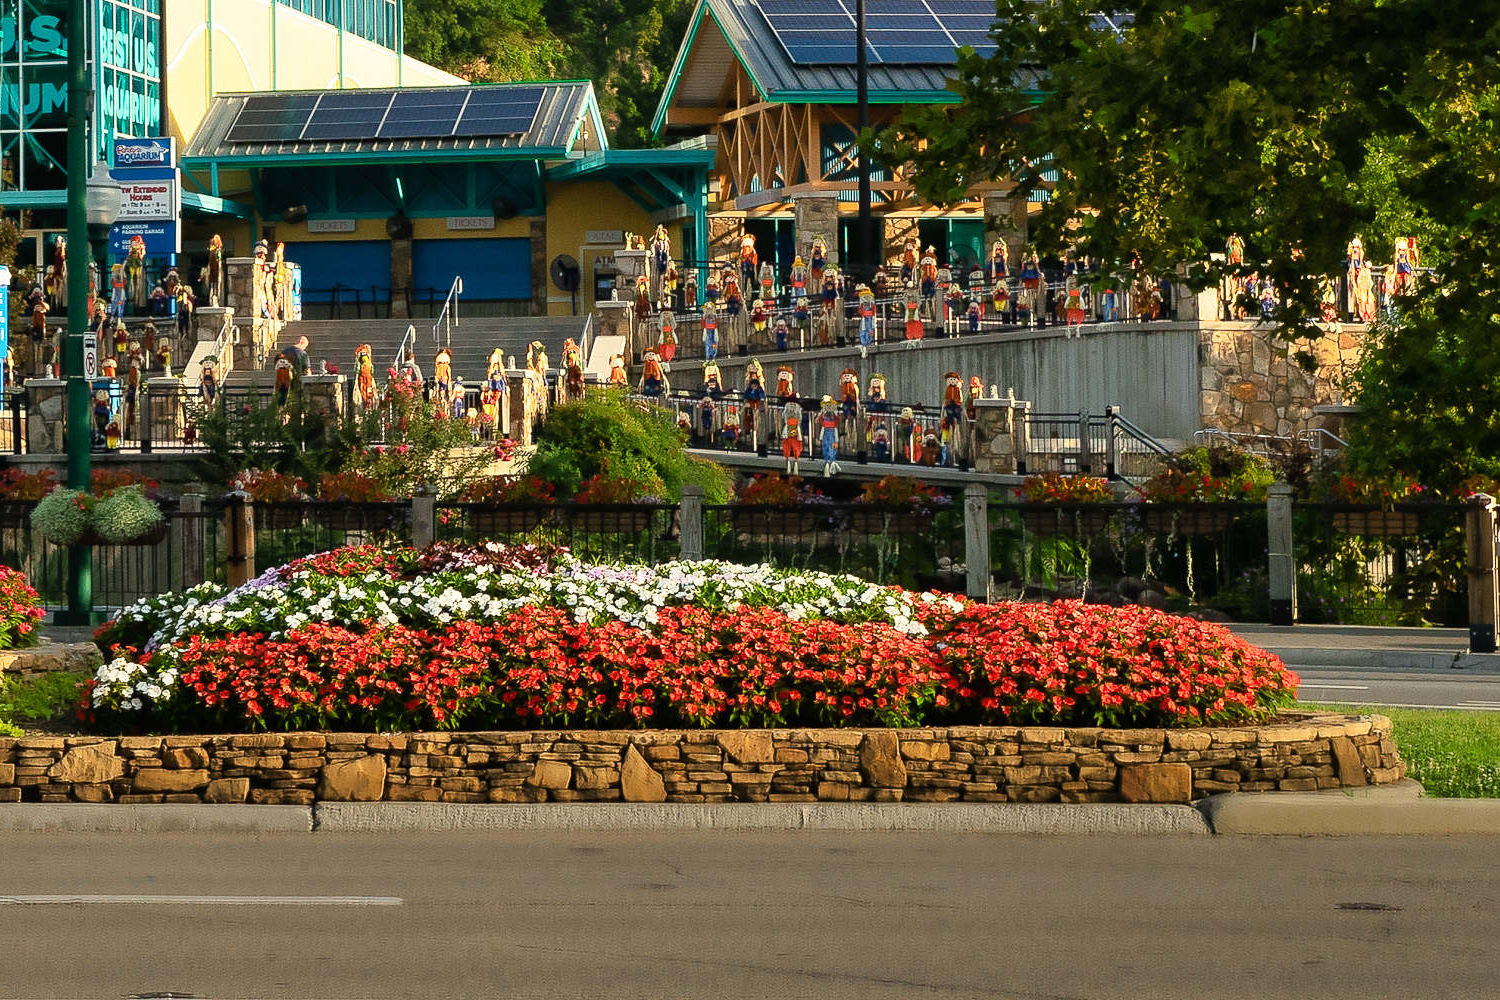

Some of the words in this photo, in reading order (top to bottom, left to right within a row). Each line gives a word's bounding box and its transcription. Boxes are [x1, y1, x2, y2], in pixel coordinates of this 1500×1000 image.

[102, 27, 129, 69] BEST
[101, 83, 160, 127] AQUARIUM
[119, 151, 164, 163] AQUARIUM
[315, 221, 348, 230] TICKETS
[454, 218, 488, 227] TICKETS
[595, 256, 616, 264] ATM
